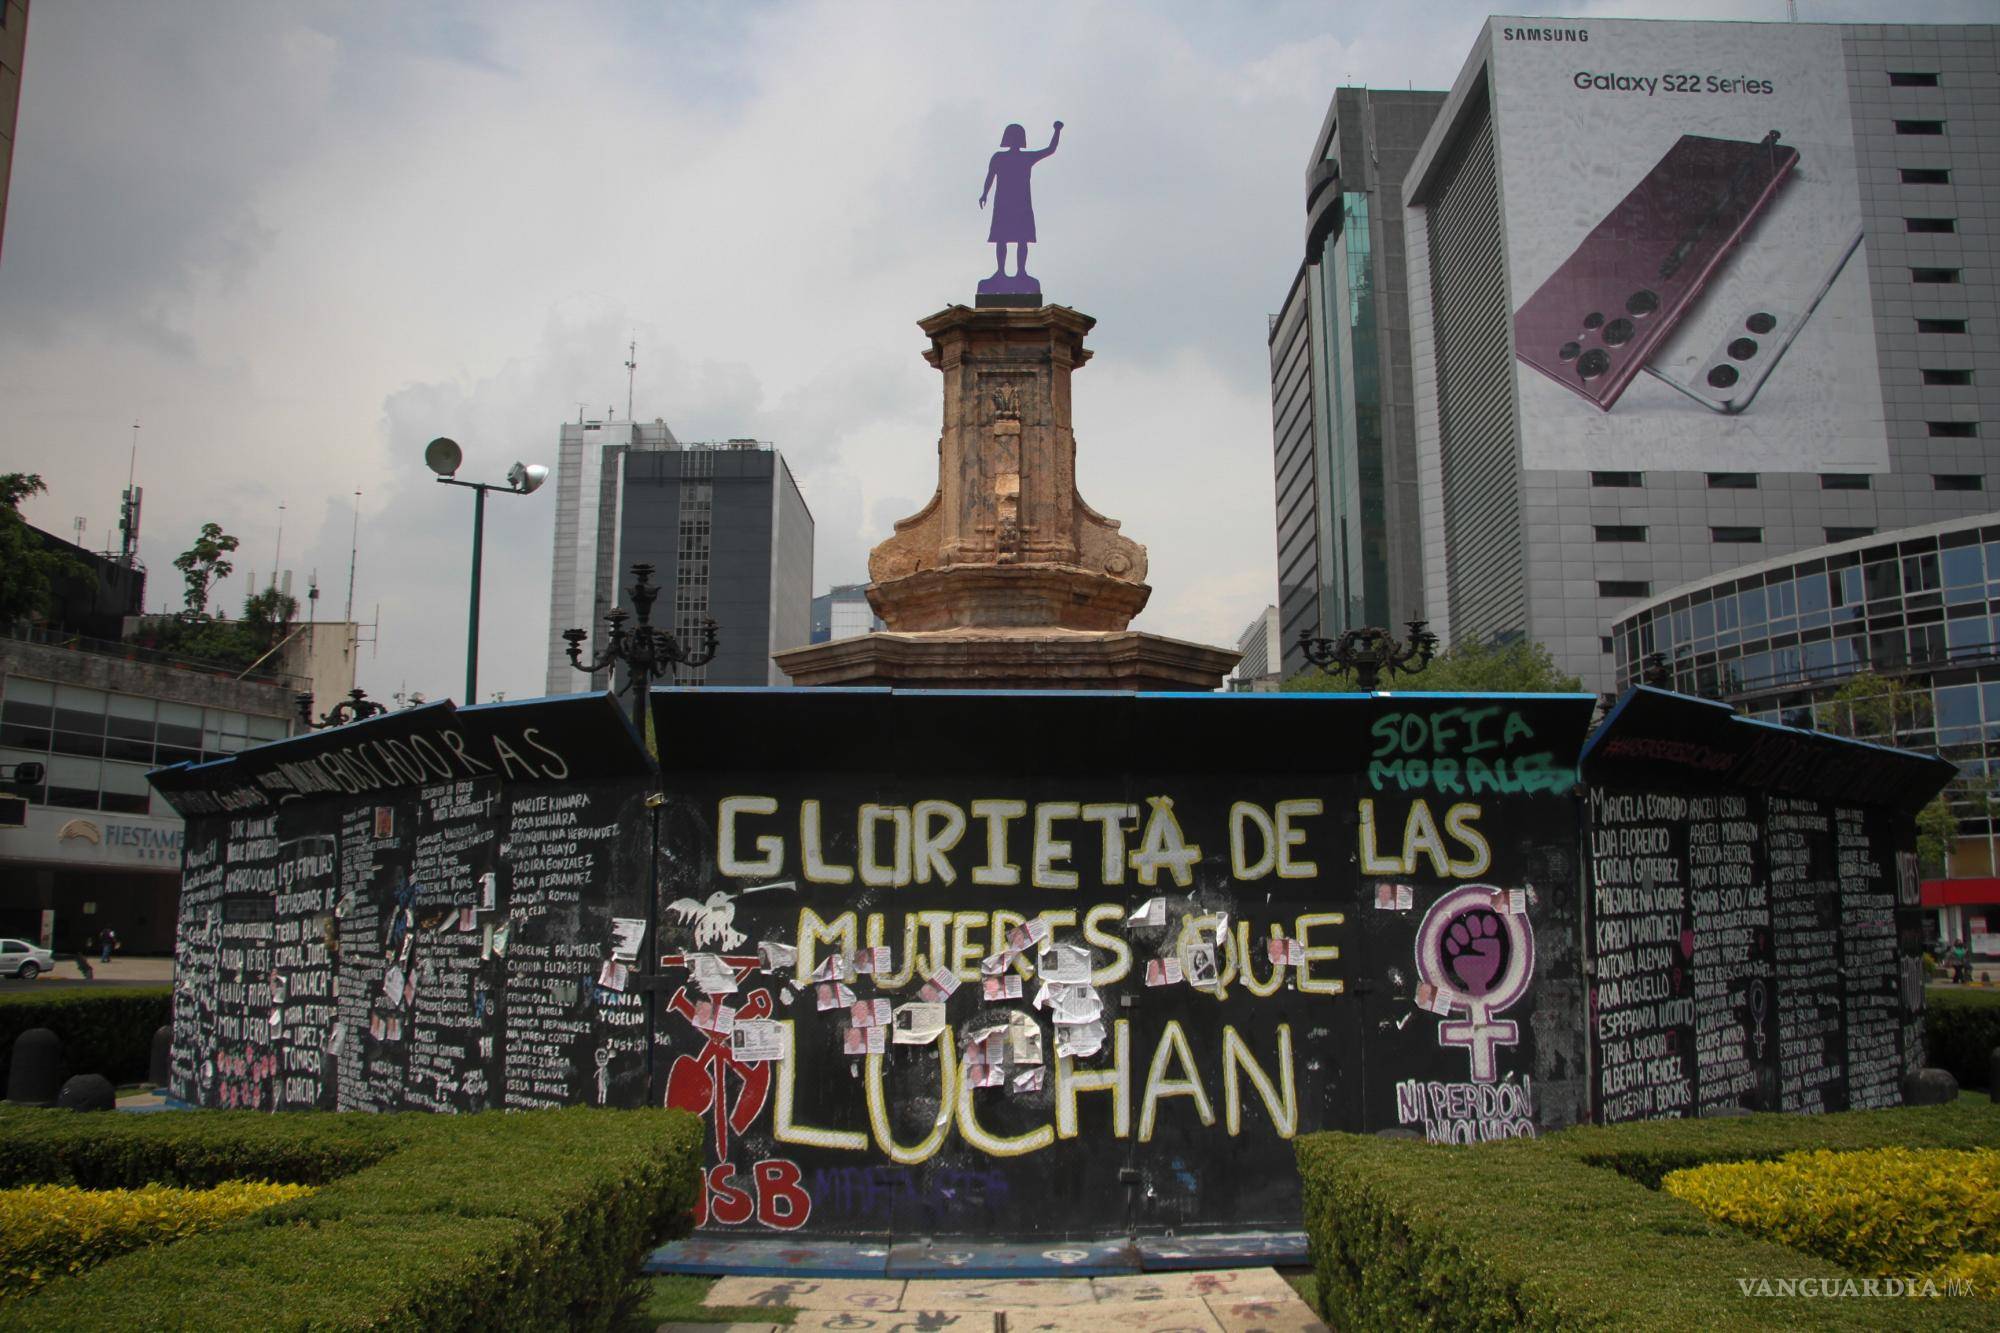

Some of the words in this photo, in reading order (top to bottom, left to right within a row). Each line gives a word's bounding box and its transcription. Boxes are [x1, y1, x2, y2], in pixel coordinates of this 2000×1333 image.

[1504, 28, 1588, 42] SAMSUNG
[1574, 72, 1658, 97] Galaxy
[1663, 74, 1702, 93] S22
[1707, 75, 1774, 95] Series
[1371, 706, 1535, 758] SOFIA
[512, 817, 535, 831] ROSA
[717, 795, 1203, 890] GLORIETA
[1229, 799, 1325, 881] DE
[1359, 798, 1492, 880] LAS
[1592, 829, 1618, 858] LIDIA
[512, 877, 536, 891] SARA
[549, 889, 581, 903] ROMAN
[1596, 919, 1630, 956] KAREN
[1177, 912, 1346, 1002] QUE
[1597, 952, 1636, 980] ANTONIA
[601, 992, 643, 1008] TANIA
[599, 1008, 645, 1027] YOSELIN
[1598, 1005, 1656, 1040] ESPERANZA
[774, 1018, 1300, 1165] LUCHAN
